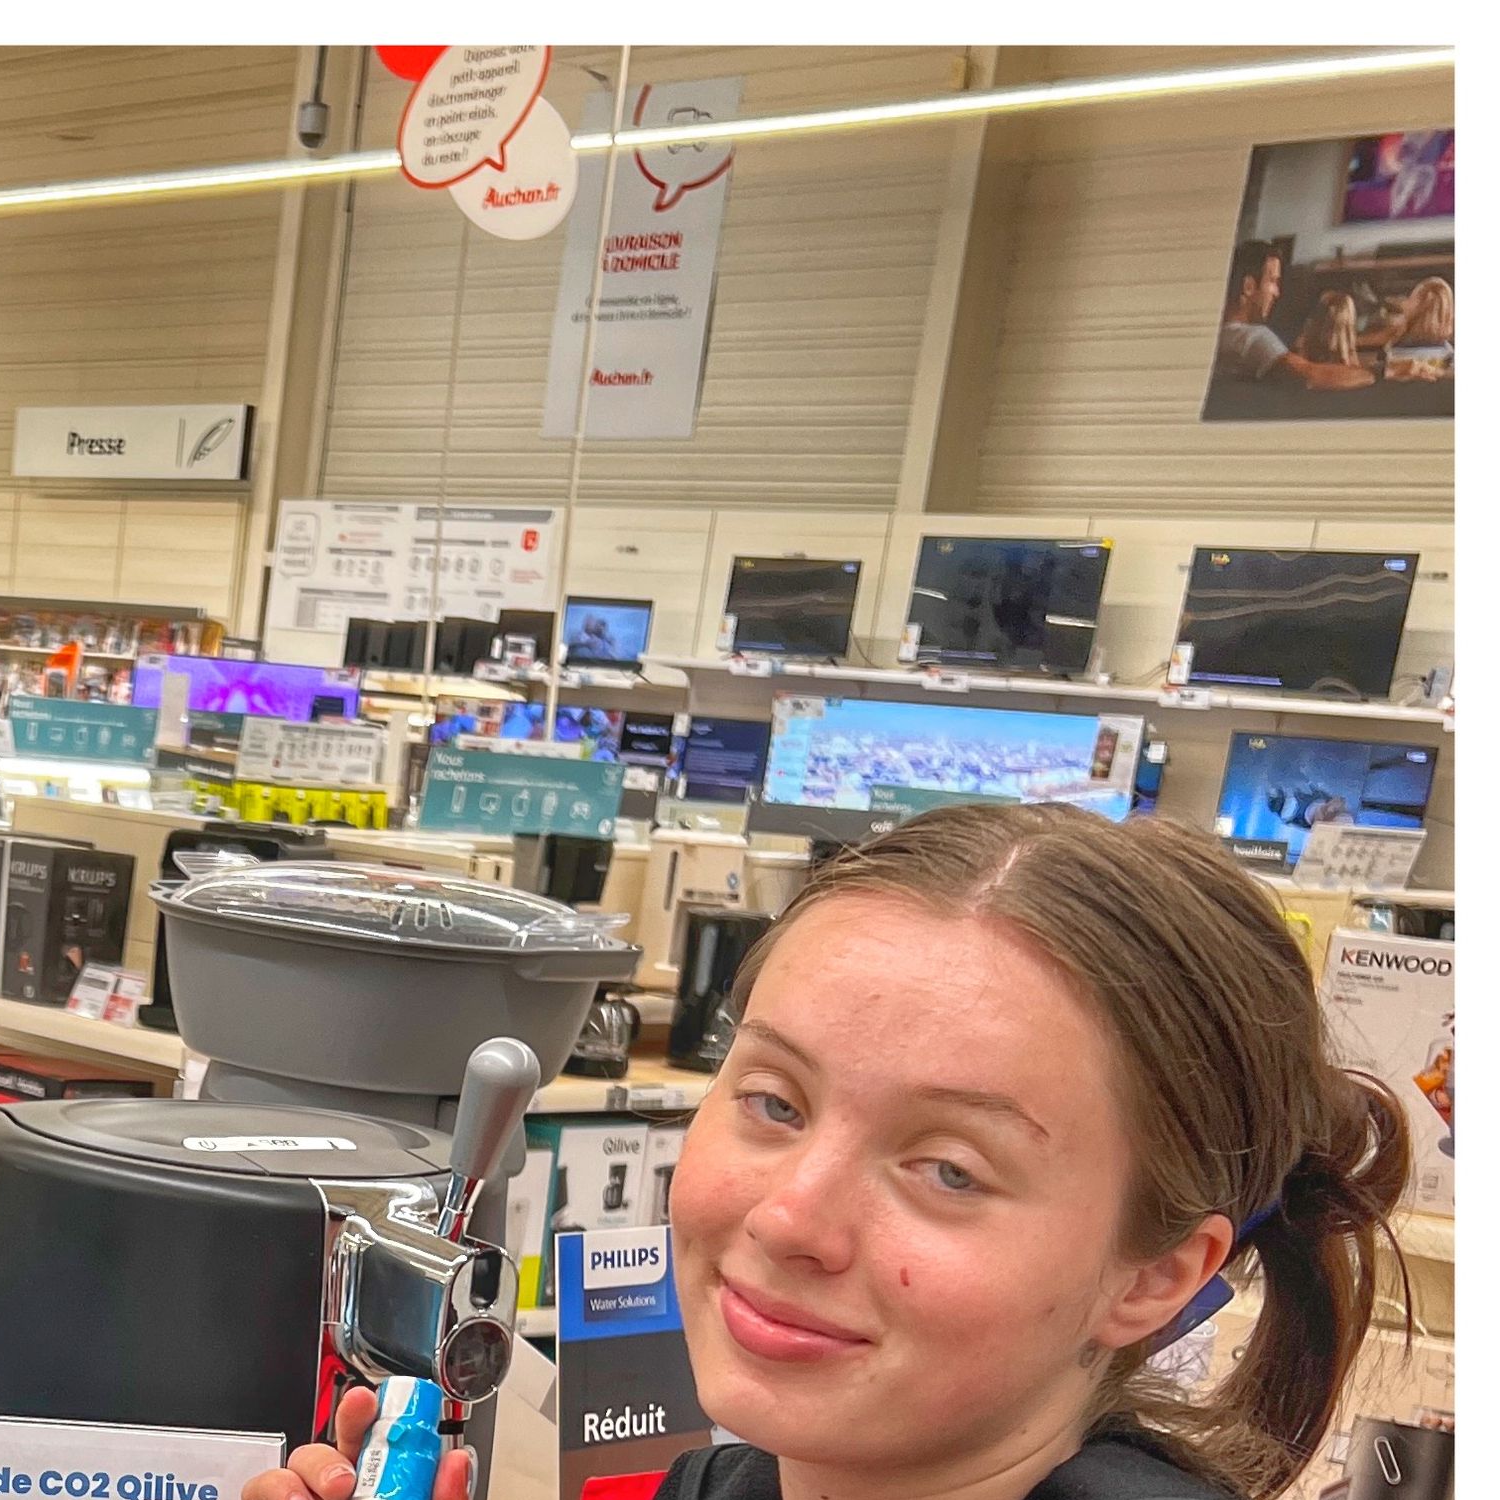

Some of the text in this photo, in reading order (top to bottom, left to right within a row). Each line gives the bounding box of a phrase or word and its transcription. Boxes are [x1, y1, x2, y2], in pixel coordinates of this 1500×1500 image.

[67, 432, 125, 456] Presse
[1341, 948, 1452, 976] KENWOOD
[602, 1136, 641, 1157] Qilive
[591, 1247, 660, 1270] PHILIPS
[590, 1294, 656, 1312] Water Solutions
[584, 1403, 666, 1443] Réduit
[39, 1469, 109, 1499] CO2
